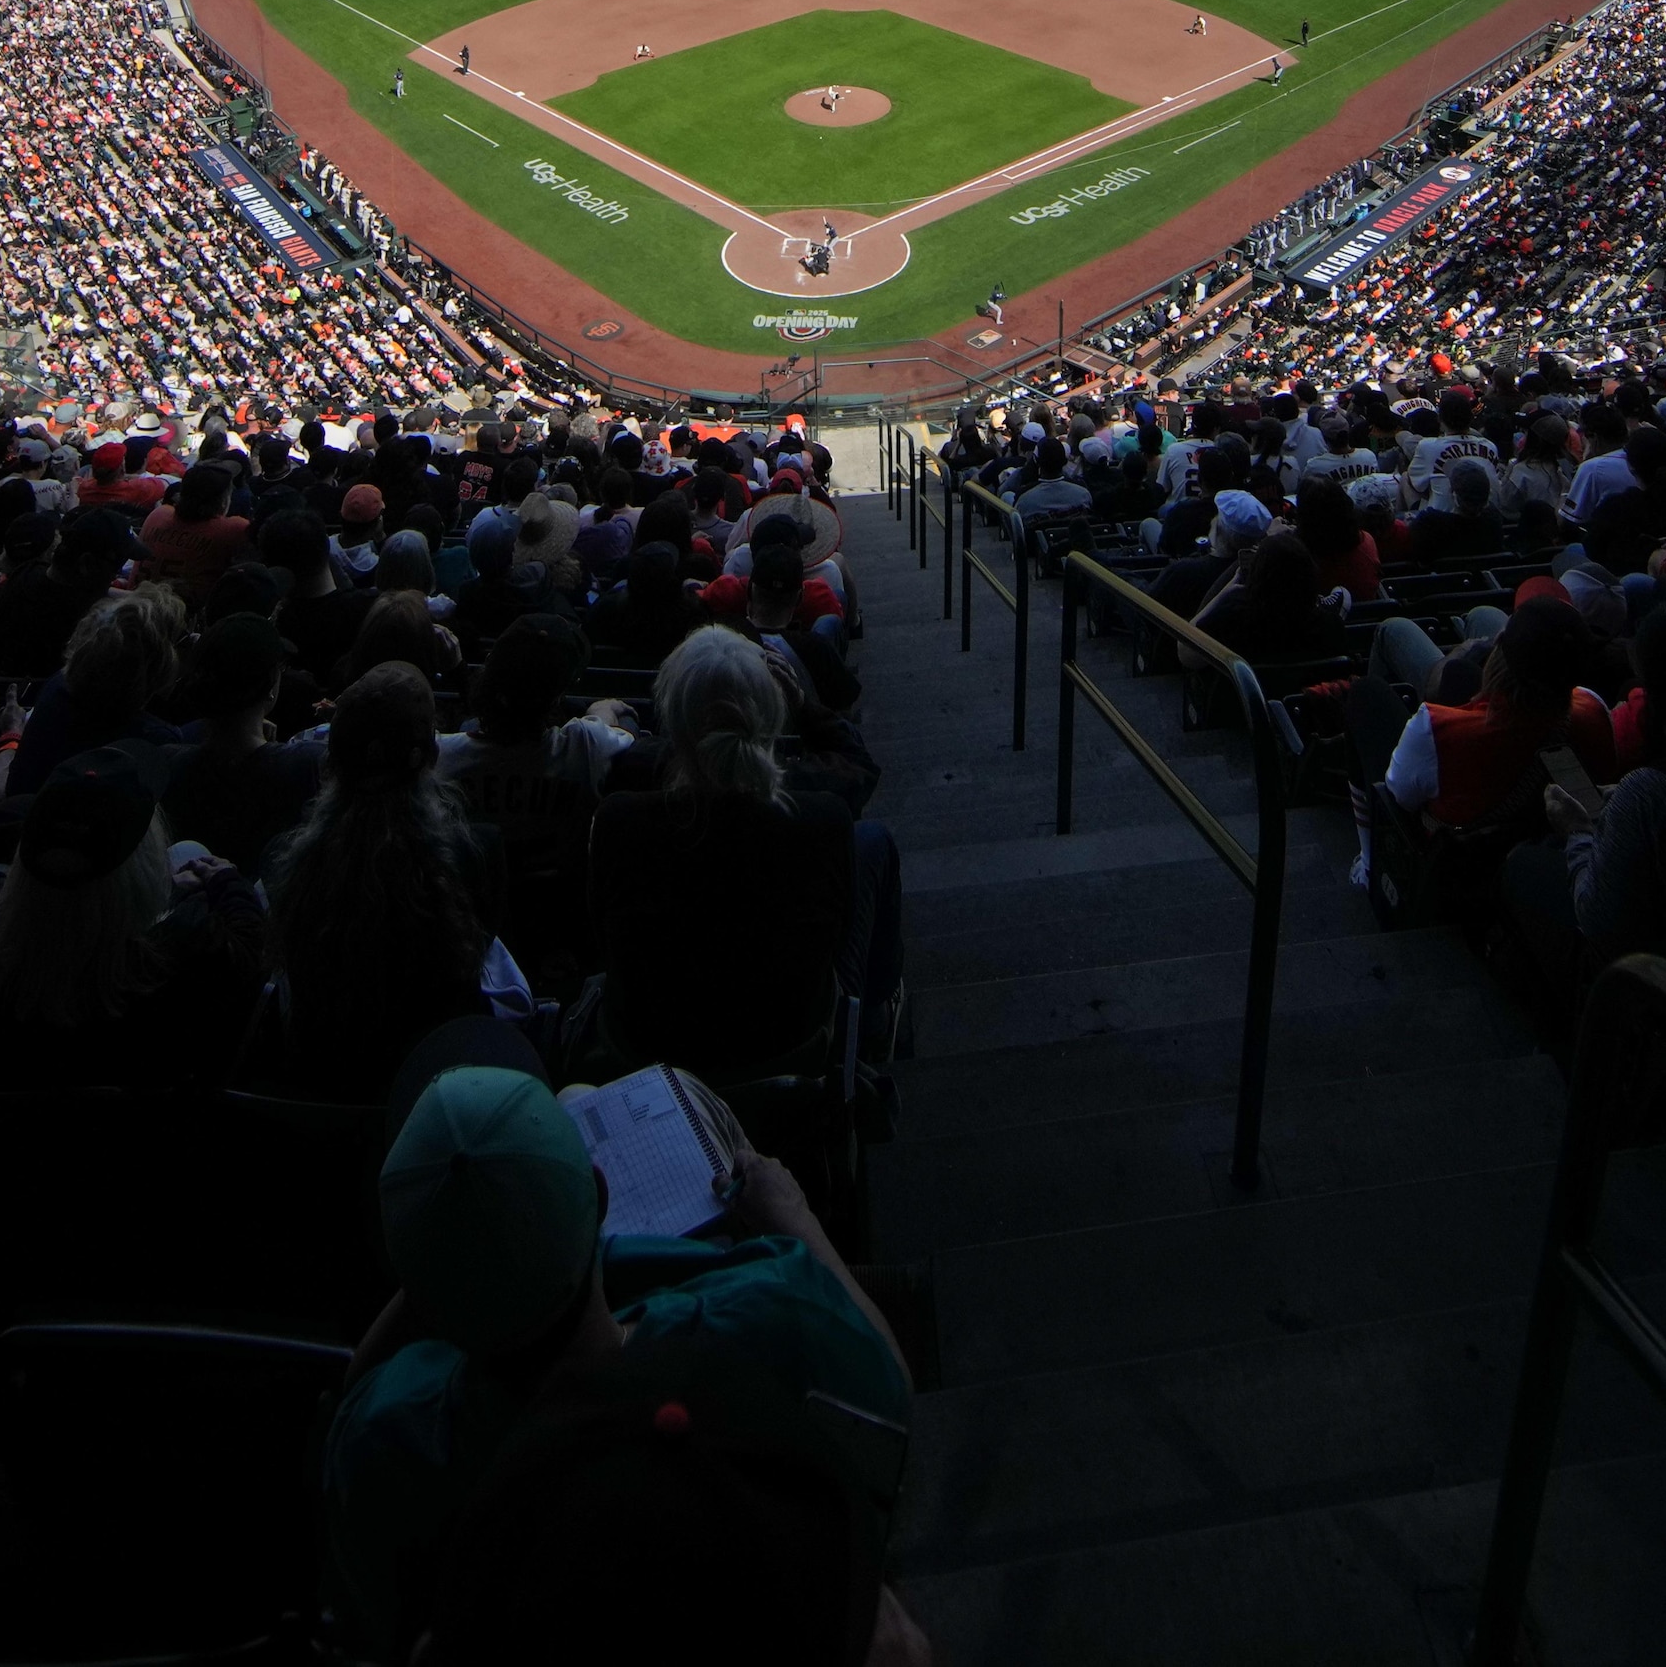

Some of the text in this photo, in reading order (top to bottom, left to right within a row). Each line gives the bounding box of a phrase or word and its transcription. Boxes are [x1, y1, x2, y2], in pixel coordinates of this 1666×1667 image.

[231, 184, 262, 202] SAN
[524, 158, 629, 224] UCSF Health
[1009, 166, 1151, 225] UCSF Health
[243, 198, 297, 239] FRANCISCO
[1304, 182, 1450, 283] WELCOME TO ORACLE PARK
[279, 236, 322, 267] GIANTS
[753, 315, 858, 328] OPENING DAY
